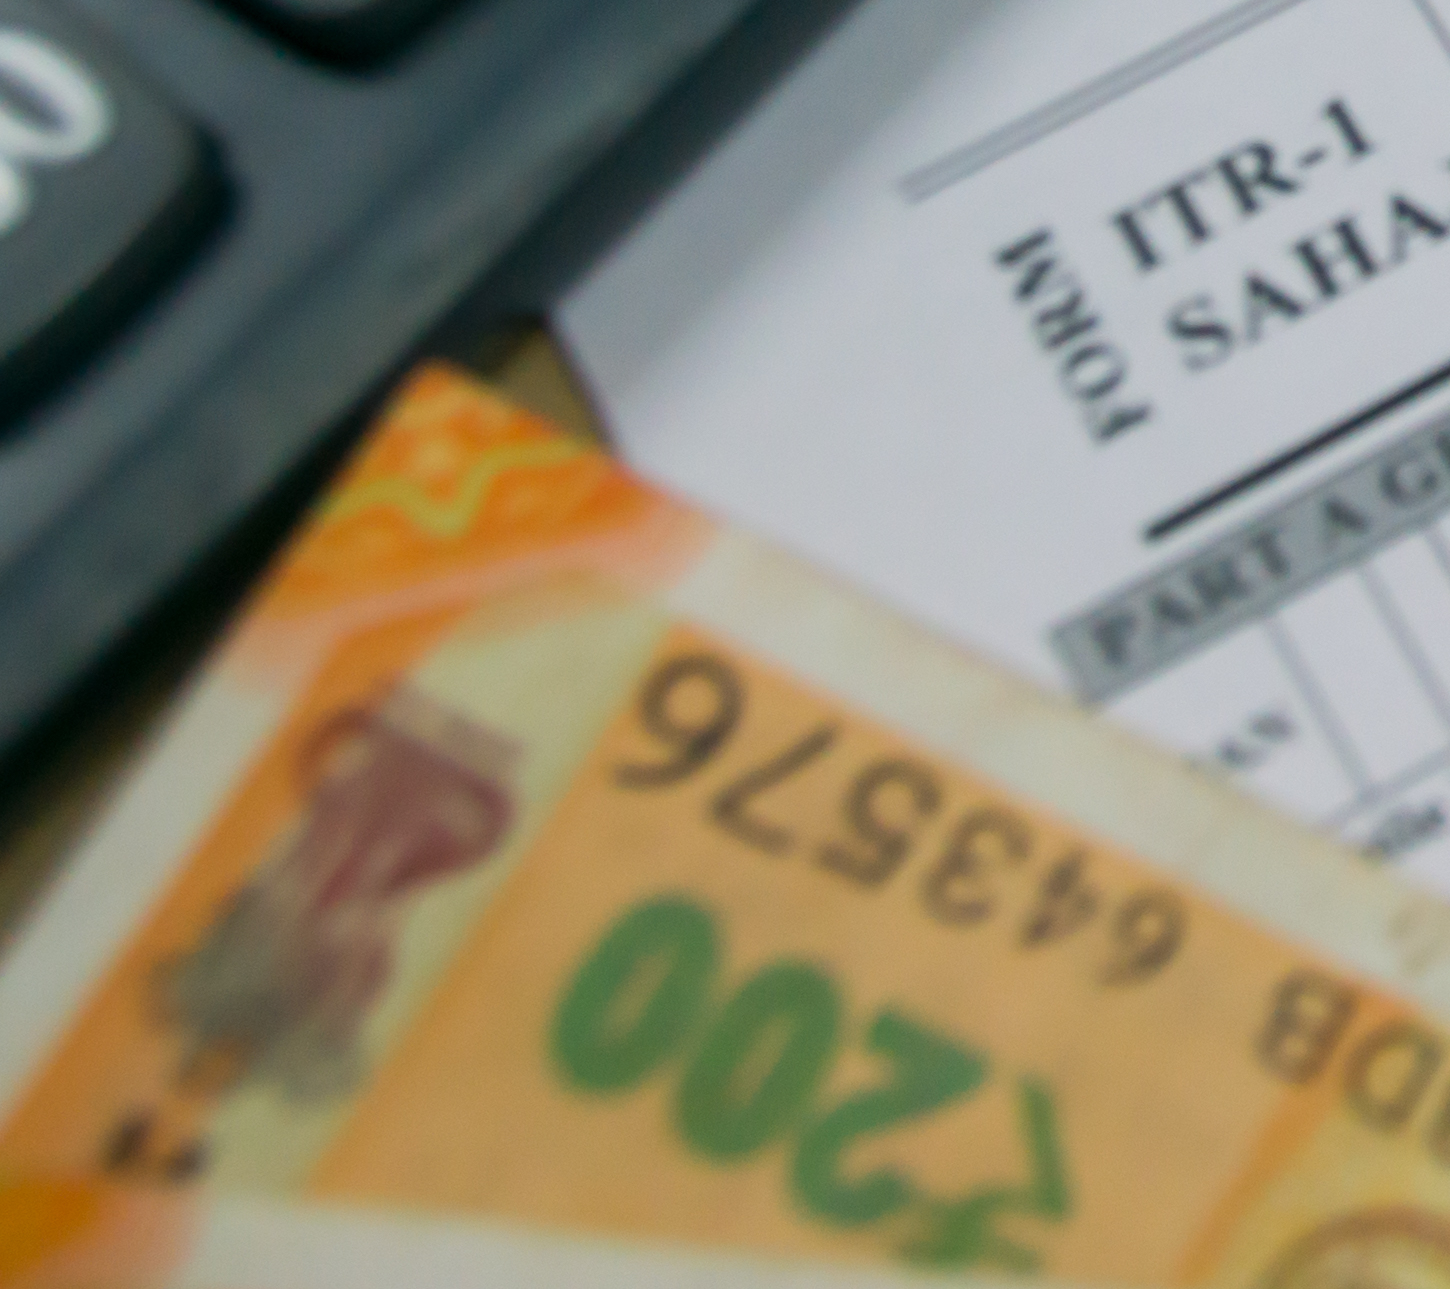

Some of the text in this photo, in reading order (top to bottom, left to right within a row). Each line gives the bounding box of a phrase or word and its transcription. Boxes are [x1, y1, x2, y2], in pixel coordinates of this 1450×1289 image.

[1108, 95, 1375, 275] ITR-1
[990, 225, 1155, 447] FORM
[1080, 513, 1293, 670] PART
[1316, 491, 1374, 543] A
[608, 649, 1194, 991] 643576
